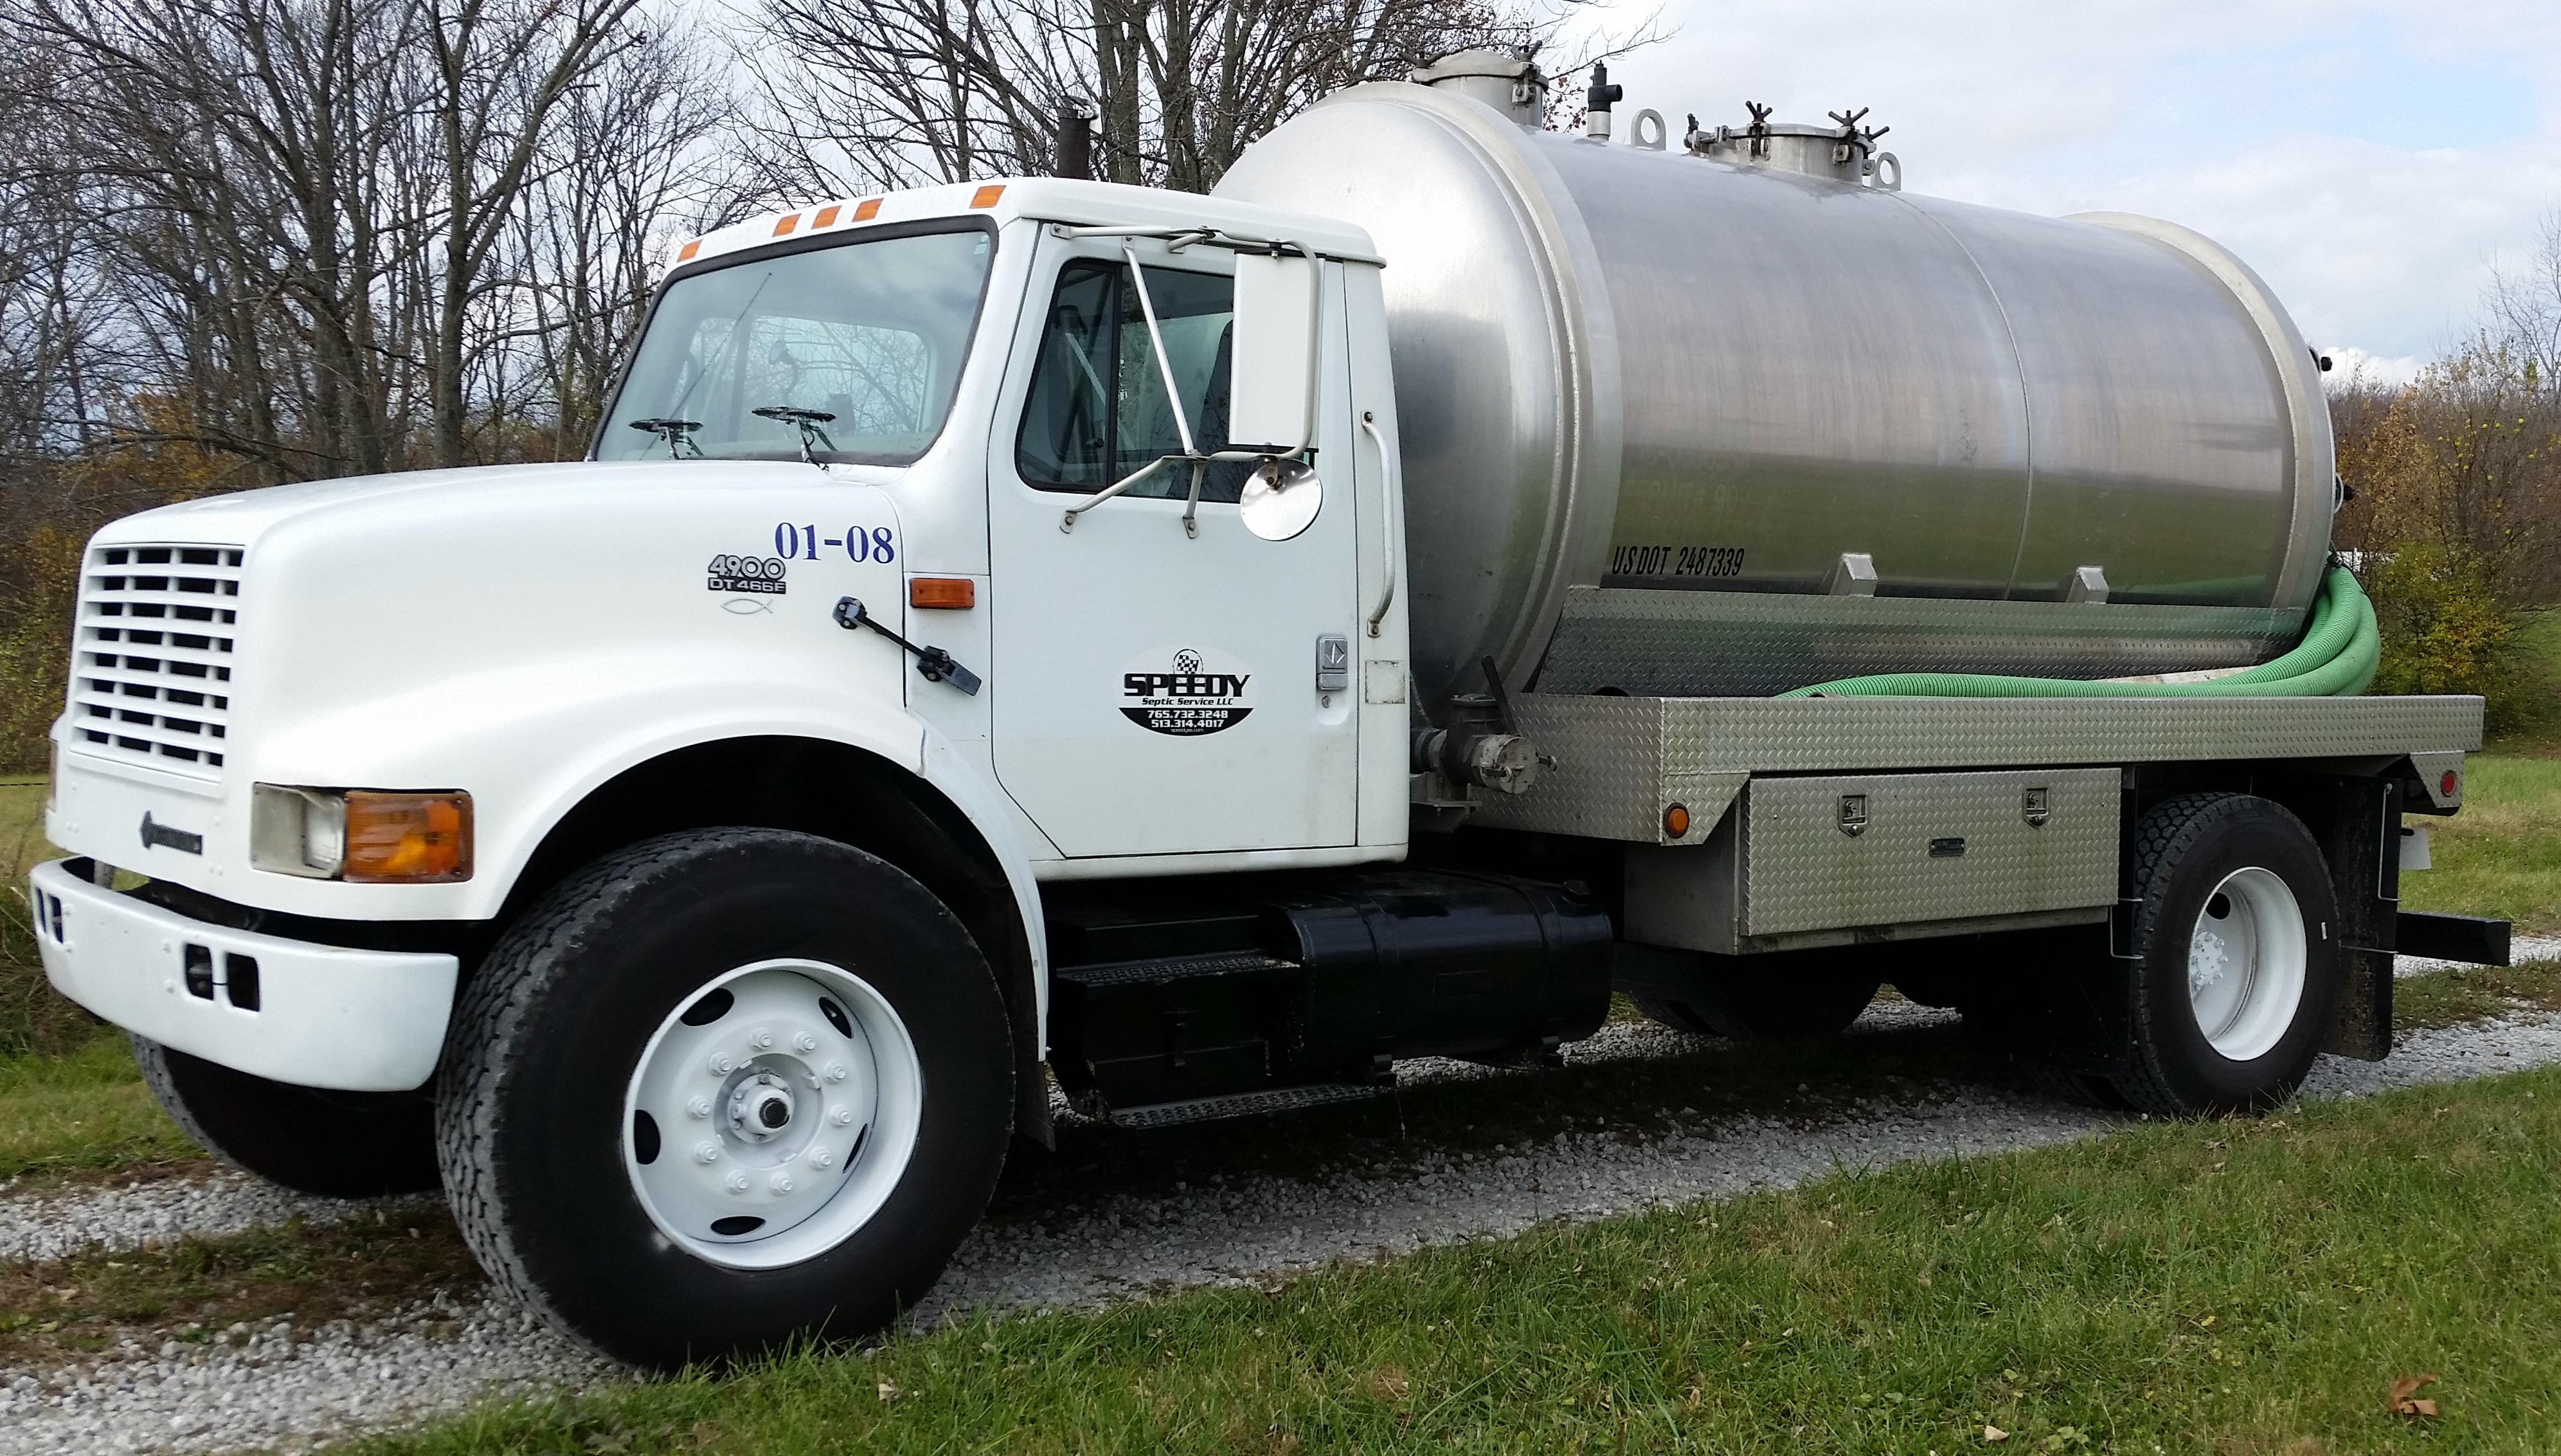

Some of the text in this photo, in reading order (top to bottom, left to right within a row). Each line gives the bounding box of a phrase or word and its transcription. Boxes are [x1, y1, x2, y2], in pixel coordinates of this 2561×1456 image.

[775, 522, 895, 564] 01-08
[708, 555, 786, 579] 4900
[1675, 546, 1745, 576] 2487339
[1124, 674, 1251, 697] SPEEDY
[1142, 697, 1174, 706] Septic
[1147, 710, 1228, 719] 765.732.3248
[1151, 719, 1225, 728] 513.314.4017
